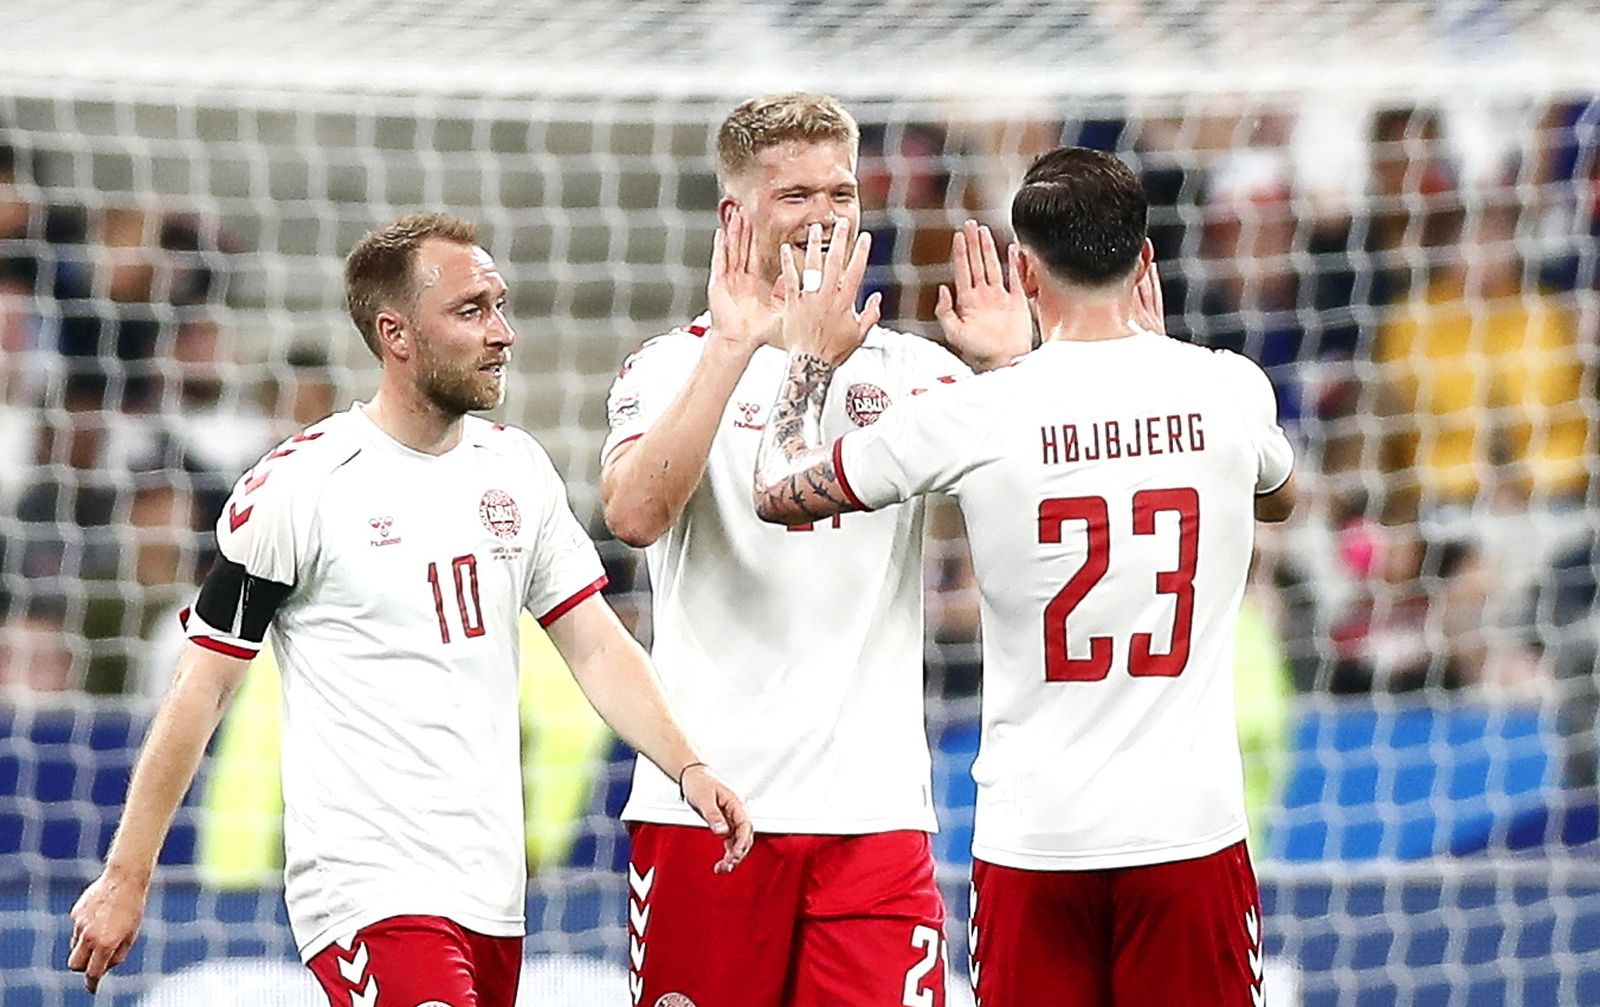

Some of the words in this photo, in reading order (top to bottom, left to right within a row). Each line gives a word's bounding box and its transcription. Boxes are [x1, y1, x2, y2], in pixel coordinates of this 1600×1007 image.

[853, 397, 884, 413] DBU
[1040, 412, 1205, 464] HØJBJERG
[427, 553, 486, 645] 10
[1038, 487, 1200, 682] 23
